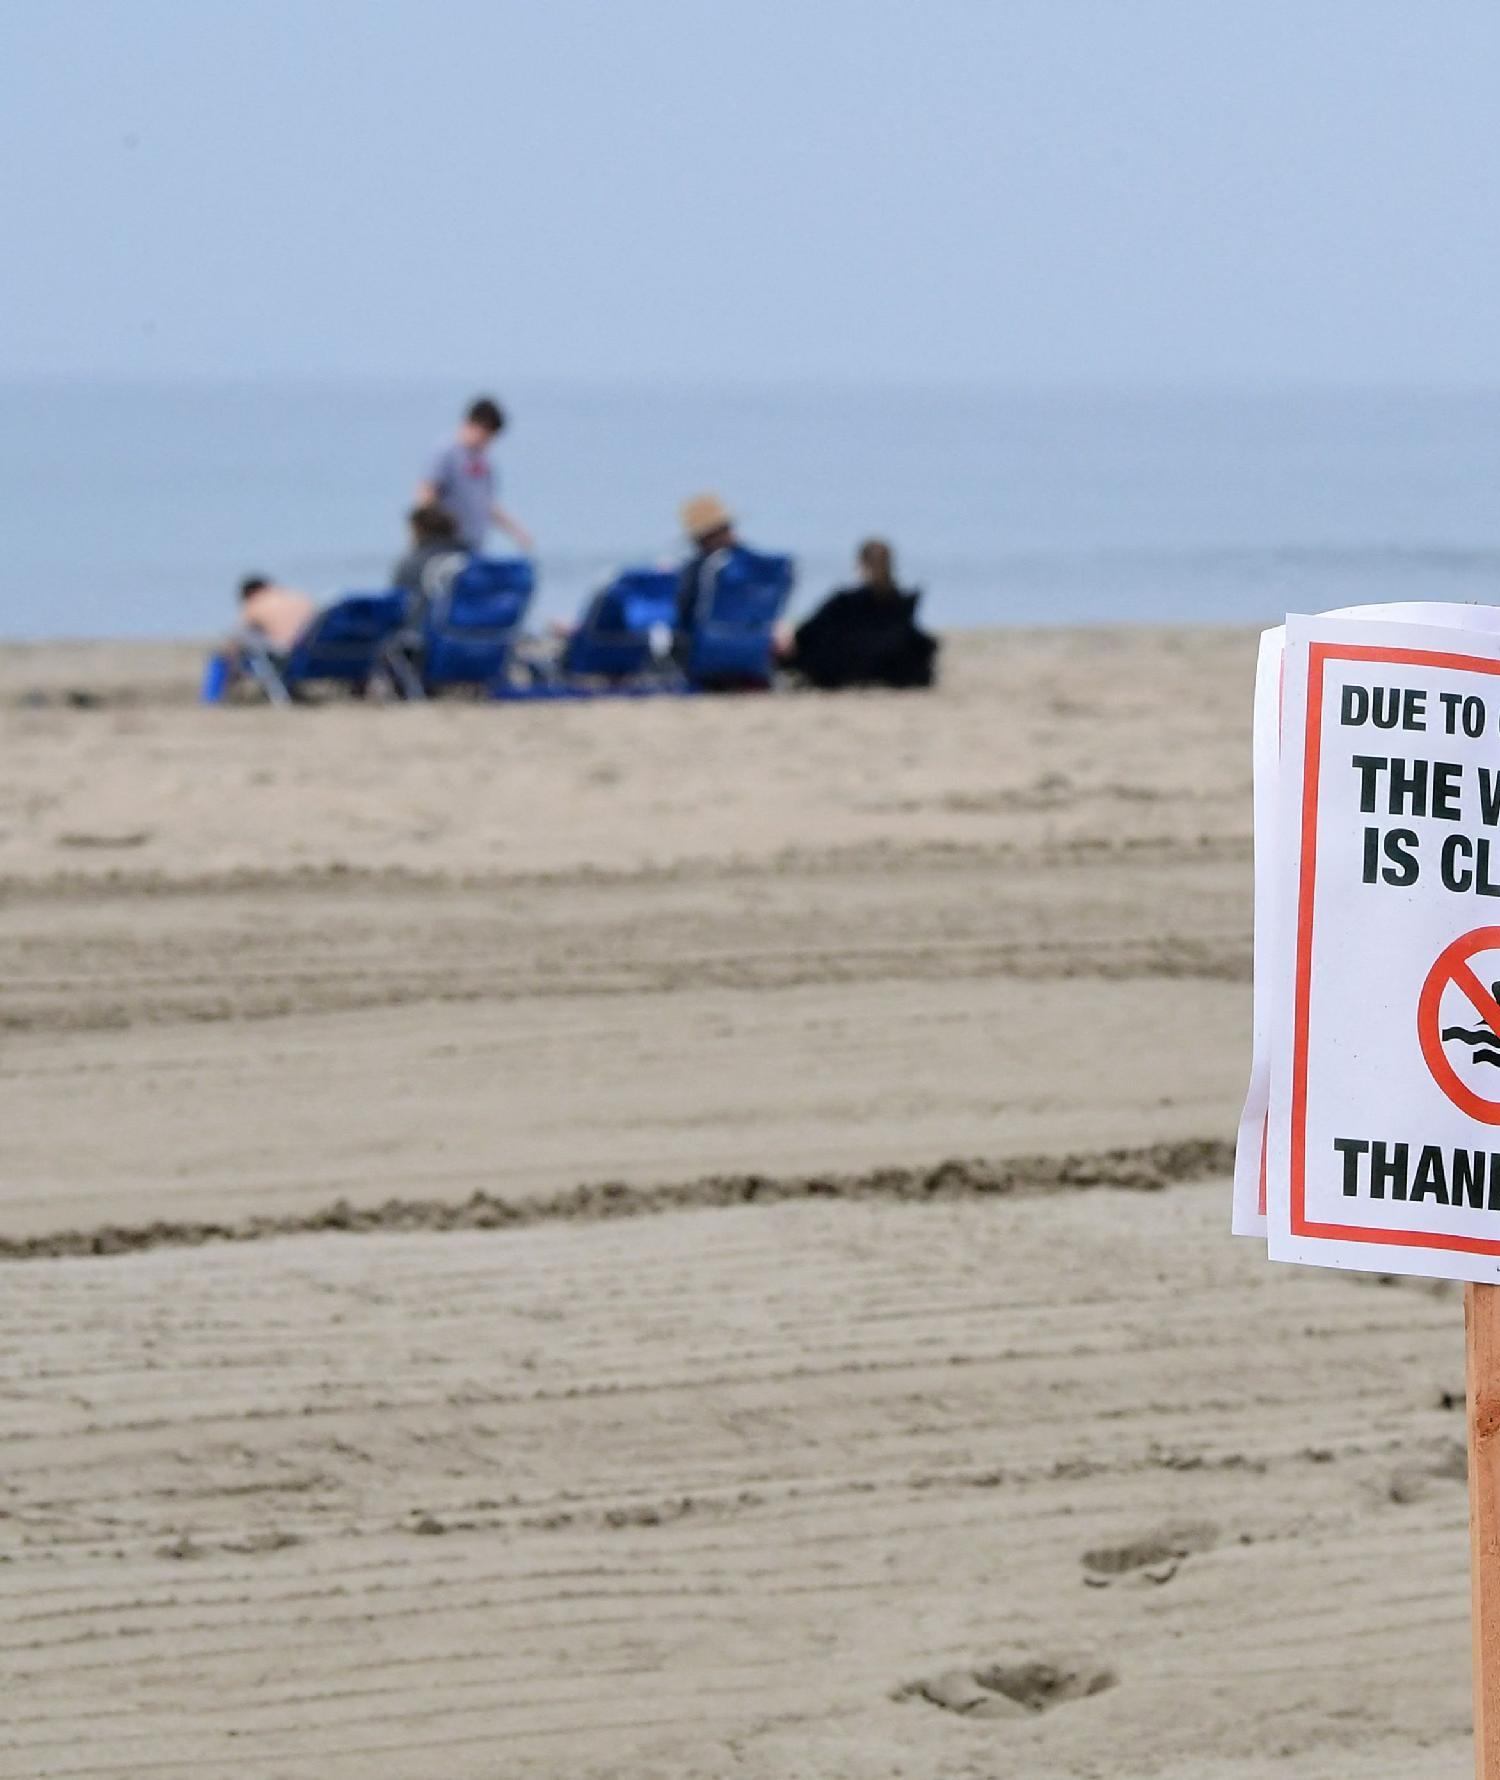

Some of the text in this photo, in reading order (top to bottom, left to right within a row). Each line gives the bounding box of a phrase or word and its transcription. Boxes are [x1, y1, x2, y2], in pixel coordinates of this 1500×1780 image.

[1341, 685, 1426, 731] DUE
[1440, 693, 1485, 738] TO
[1352, 755, 1462, 821] THE
[1363, 828, 1419, 886] IS
